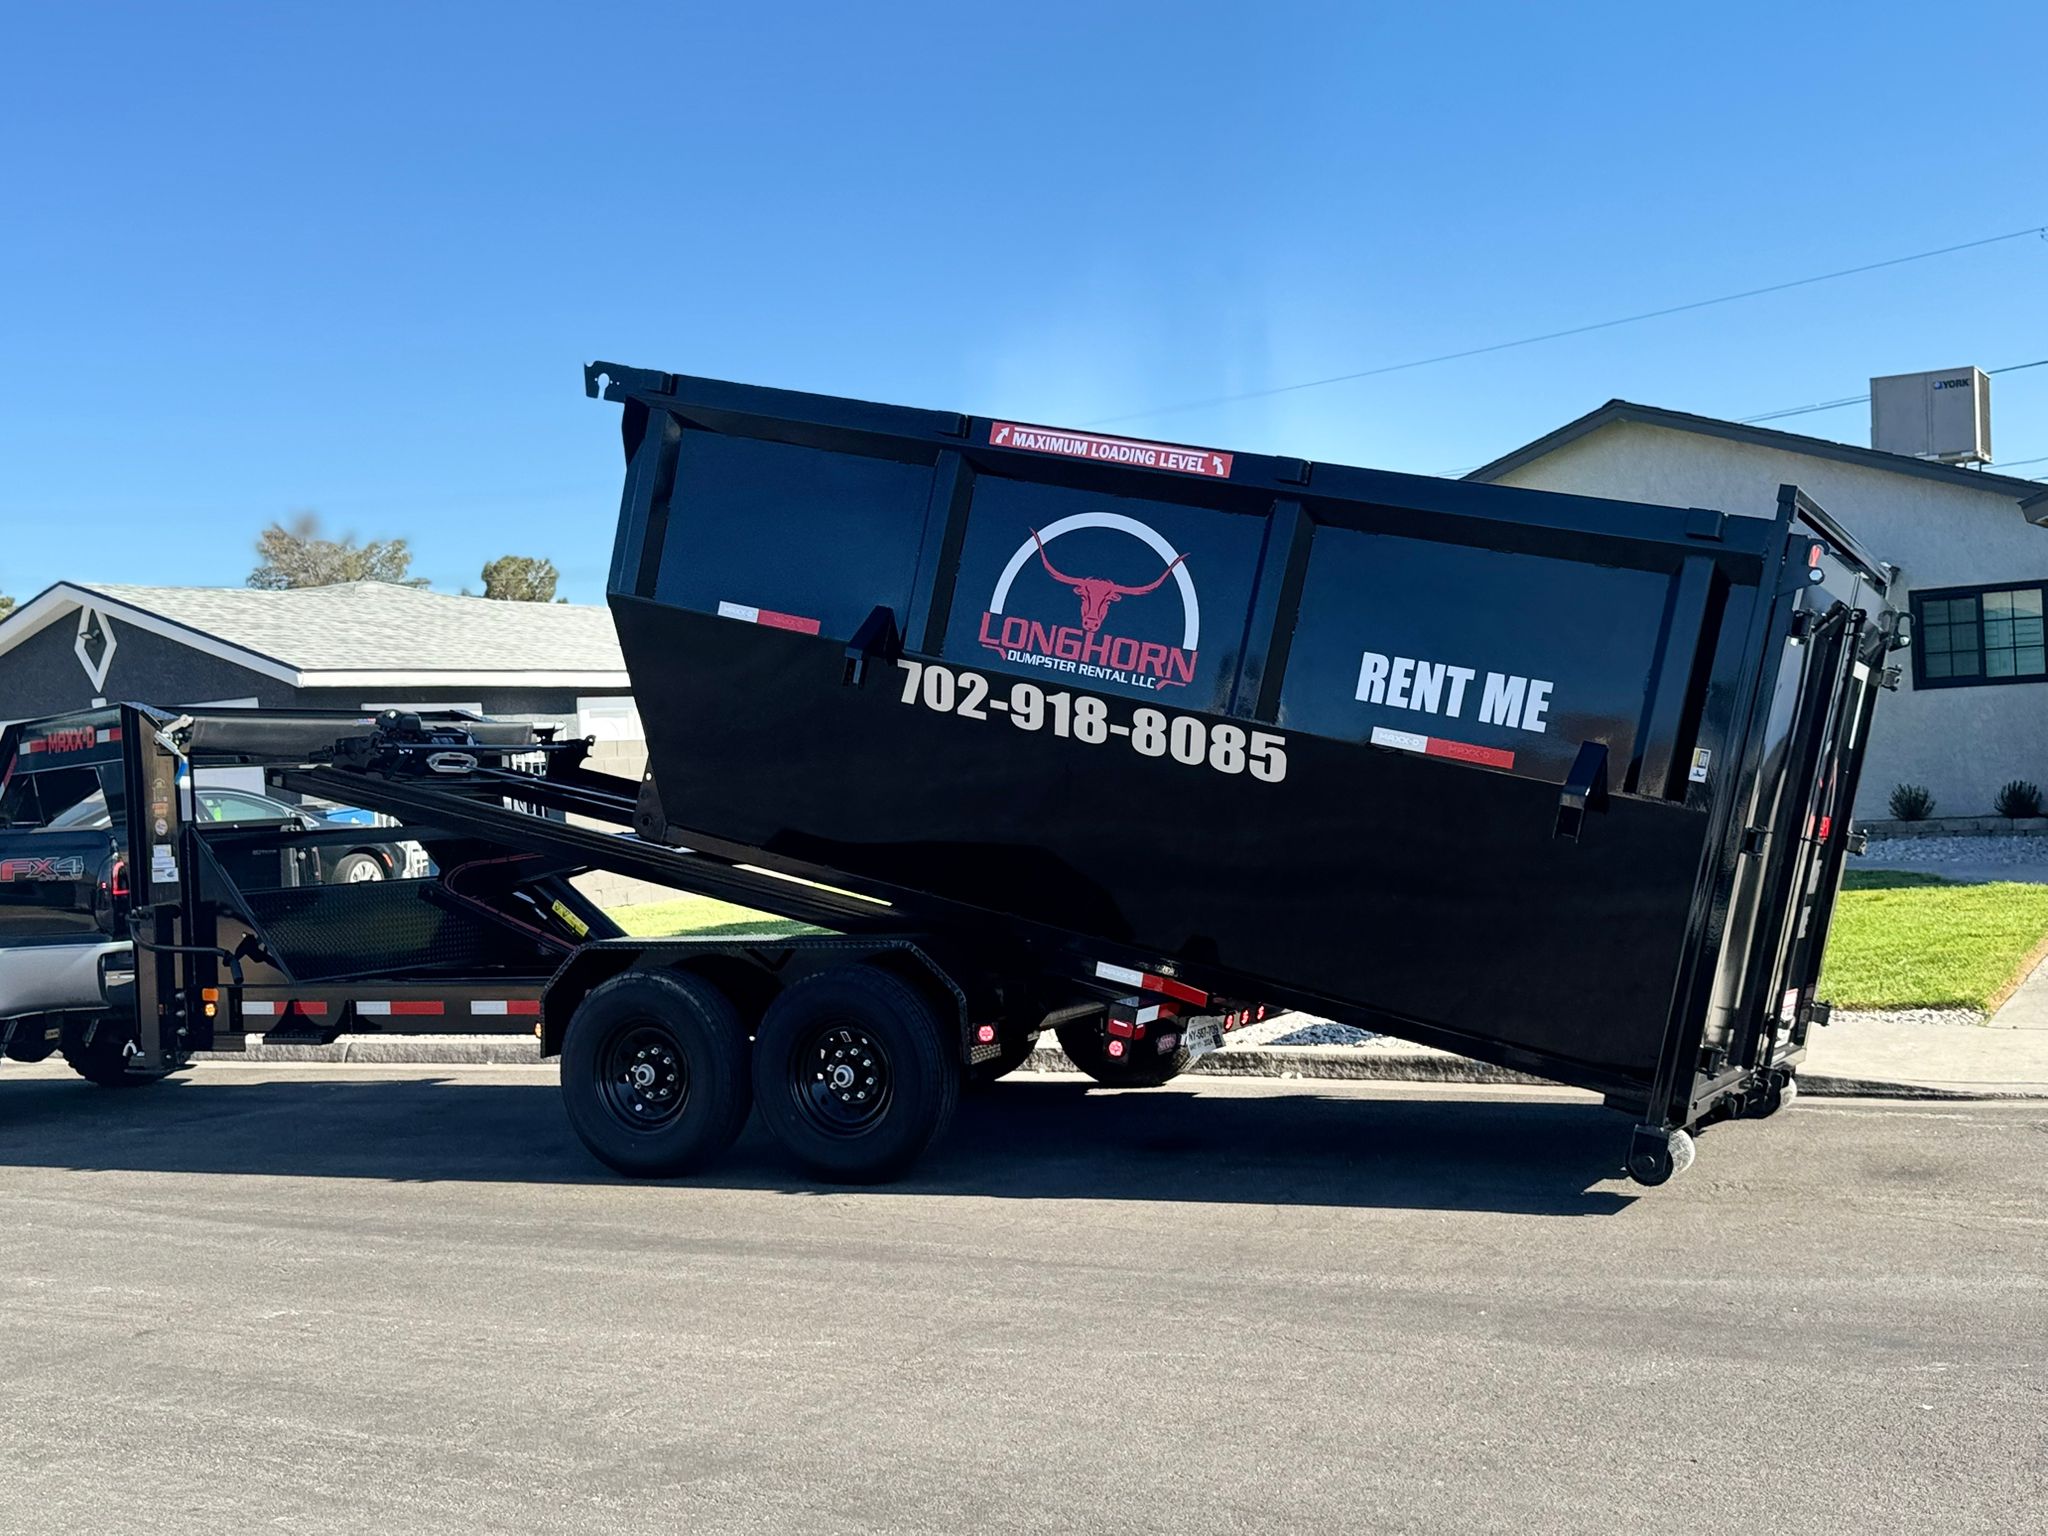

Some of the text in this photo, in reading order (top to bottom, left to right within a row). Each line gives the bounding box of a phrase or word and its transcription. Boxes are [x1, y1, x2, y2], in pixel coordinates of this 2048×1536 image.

[1942, 378, 1969, 389] YORK
[1012, 432, 1206, 472] MAXIMUM LOADING LEVEL
[978, 611, 1199, 683] LONGHORN
[1007, 650, 1156, 689] DUMPSTER RENTAL LLC
[1355, 651, 1554, 733] RENT ME
[897, 659, 1288, 783] 702-918-8085
[1379, 731, 1420, 747] MAXX-D
[0, 856, 84, 882] FX4
